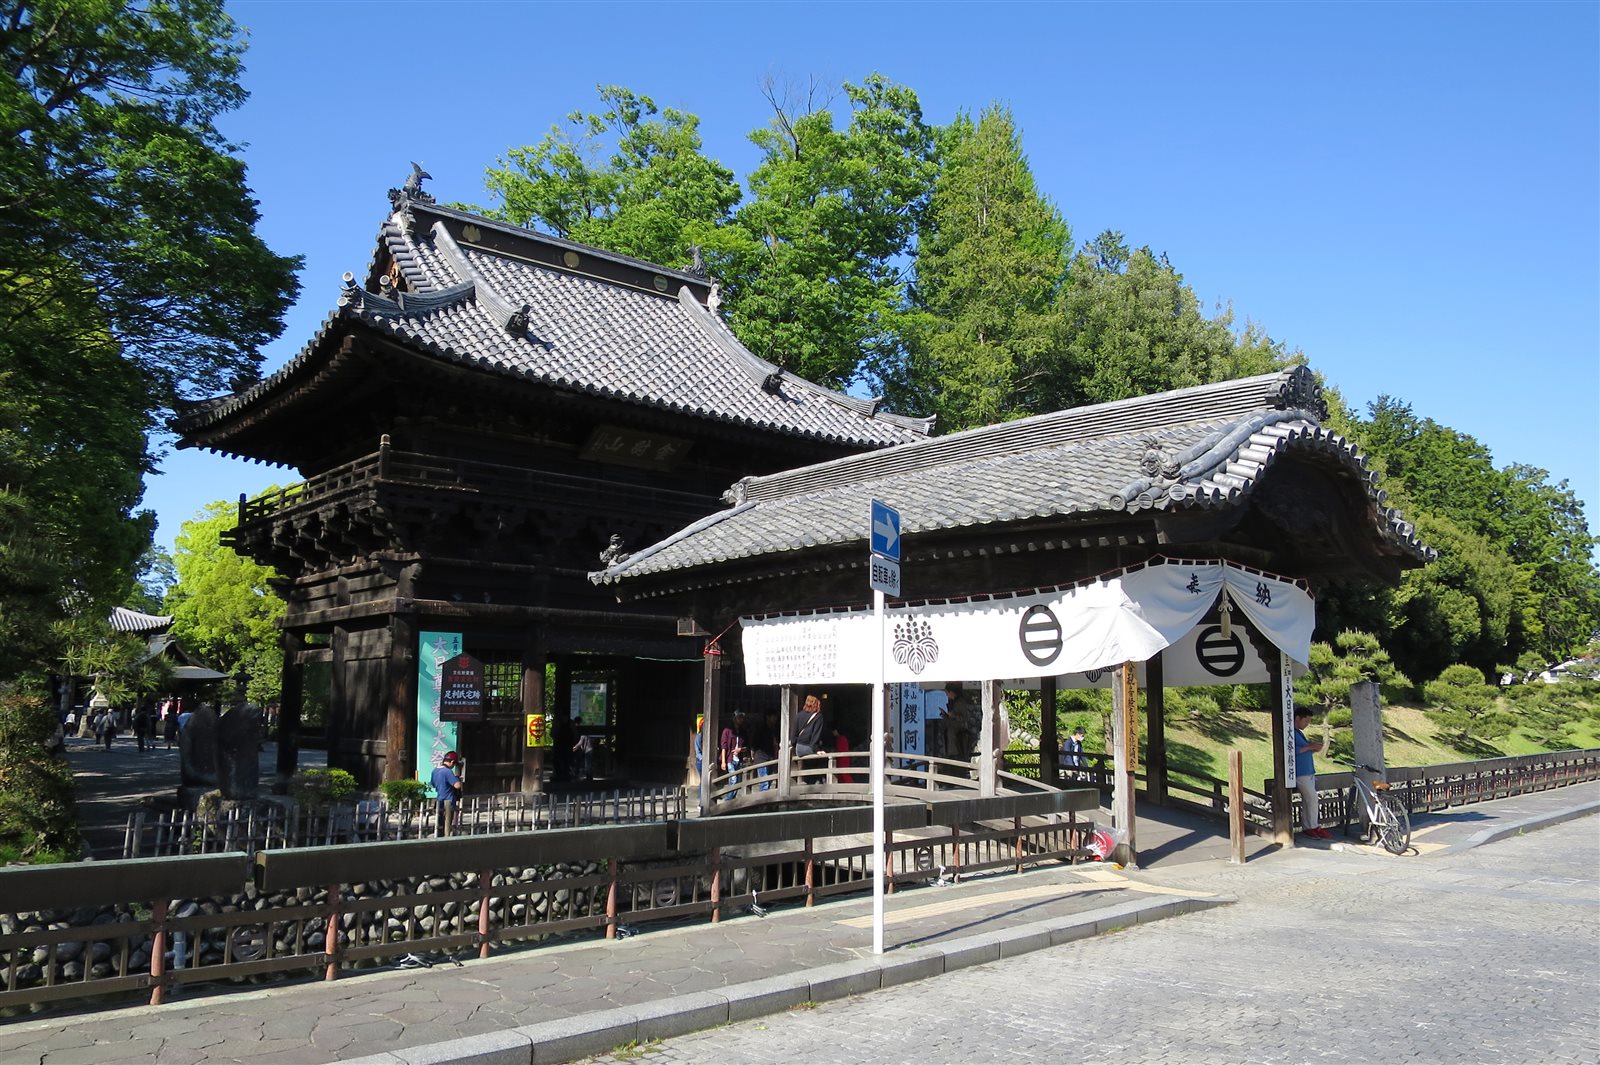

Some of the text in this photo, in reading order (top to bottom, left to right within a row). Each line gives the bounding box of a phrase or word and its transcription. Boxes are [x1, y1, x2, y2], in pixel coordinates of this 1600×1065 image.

[444, 689, 481, 699] 足利氏宅跡
